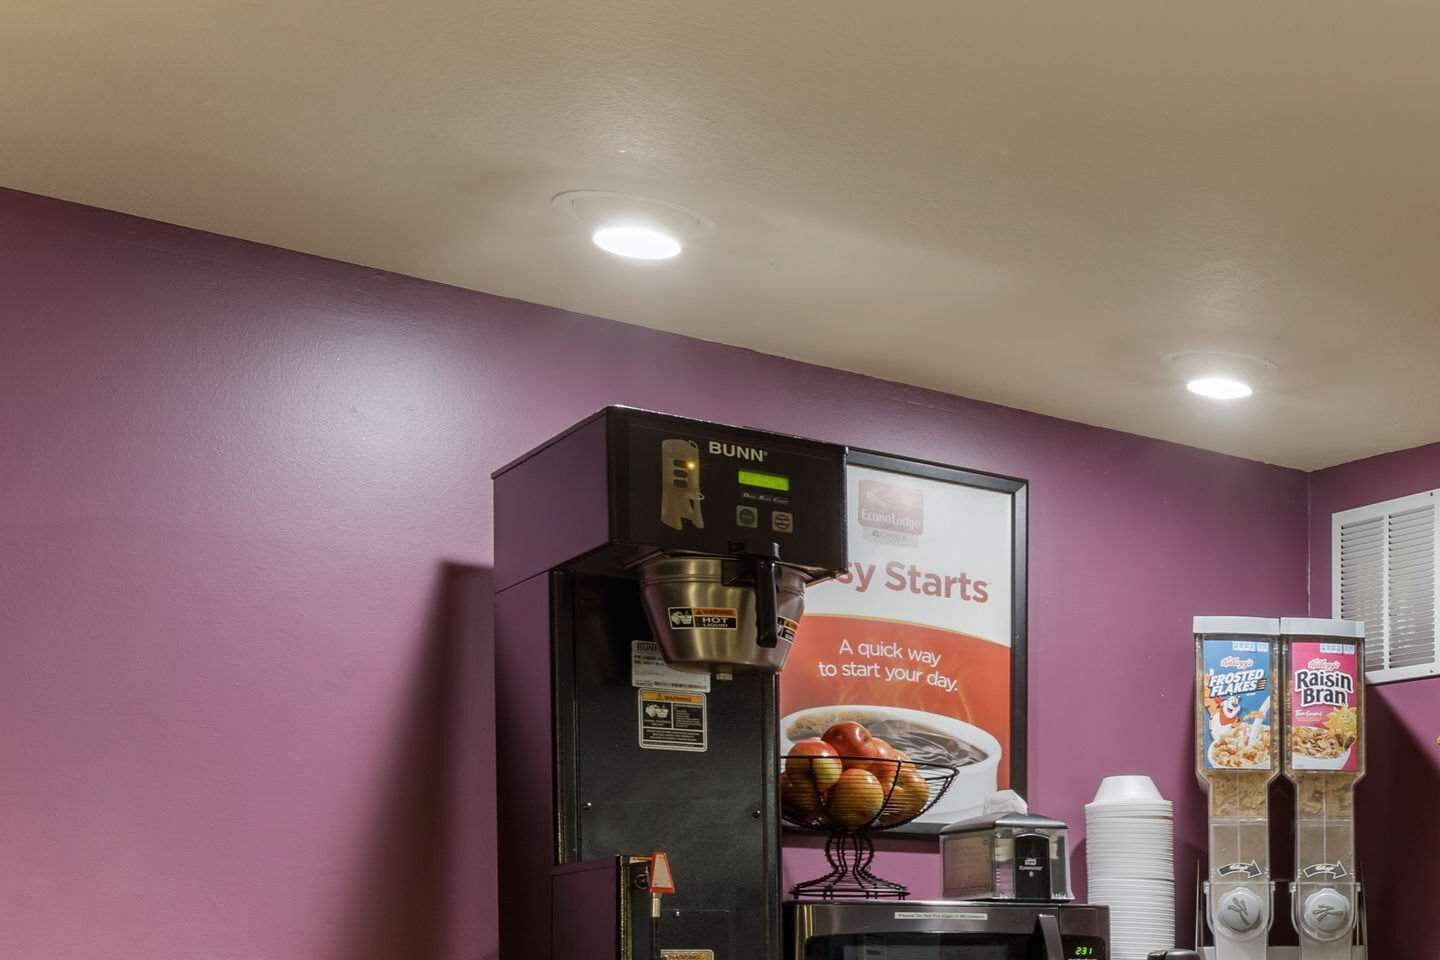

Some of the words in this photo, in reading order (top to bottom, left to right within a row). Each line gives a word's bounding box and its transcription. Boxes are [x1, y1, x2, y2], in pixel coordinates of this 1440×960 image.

[708, 440, 764, 462] BUNN
[884, 560, 990, 604] Starts
[702, 616, 729, 624] HOT
[839, 639, 853, 655] A
[857, 641, 903, 659] quick
[907, 647, 942, 668] way
[817, 661, 838, 677] to
[842, 661, 881, 678] start
[884, 666, 923, 683] your
[926, 671, 959, 692] day.
[1209, 669, 1265, 688] FROSTED
[1296, 670, 1352, 691] Raisin
[1210, 680, 1258, 698] FLAKES
[1302, 687, 1347, 706] Bran
